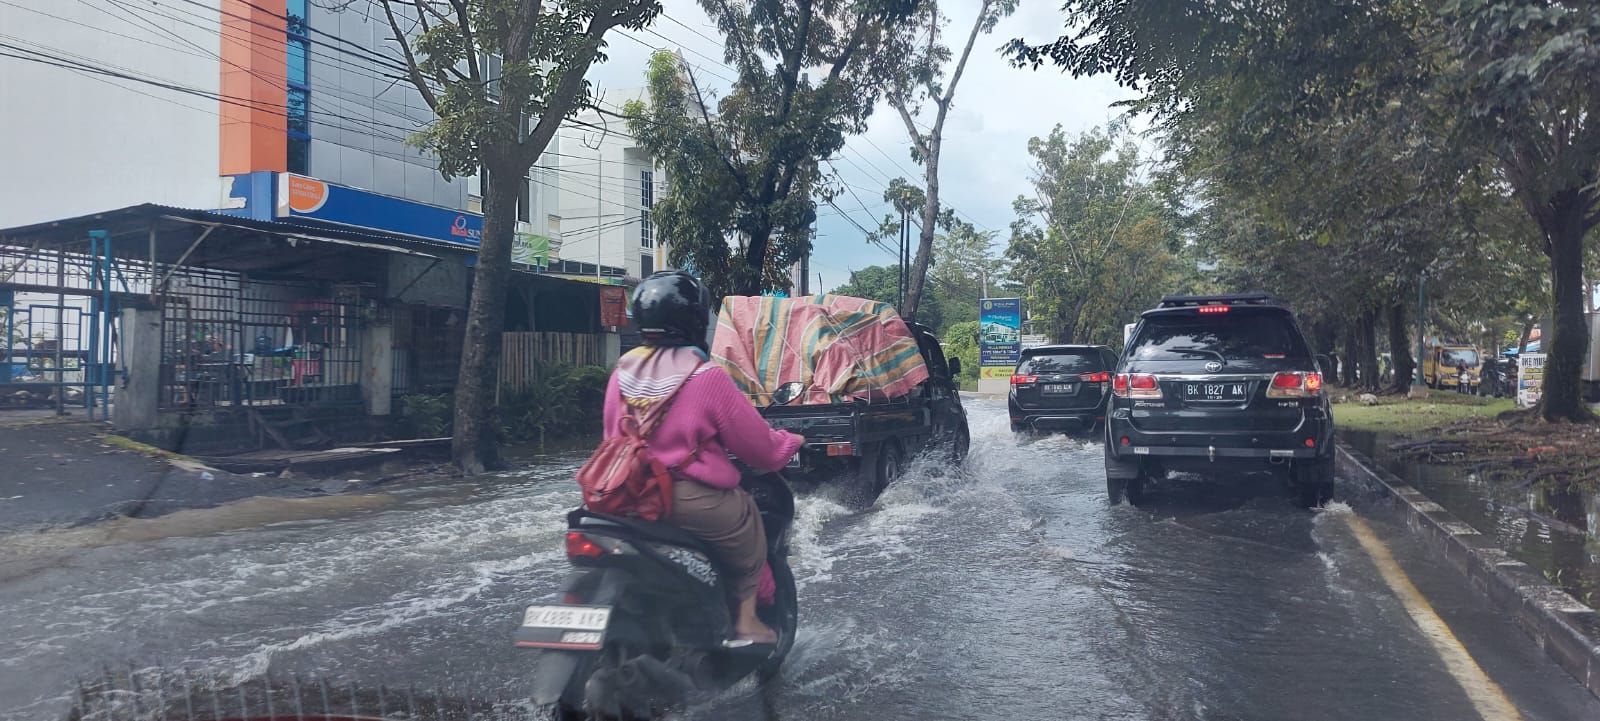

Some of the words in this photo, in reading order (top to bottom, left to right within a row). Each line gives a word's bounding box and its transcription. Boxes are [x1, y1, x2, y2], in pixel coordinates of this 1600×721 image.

[1187, 384, 1199, 395] BK
[1204, 384, 1225, 395] 1827
[1232, 384, 1243, 395] AK
